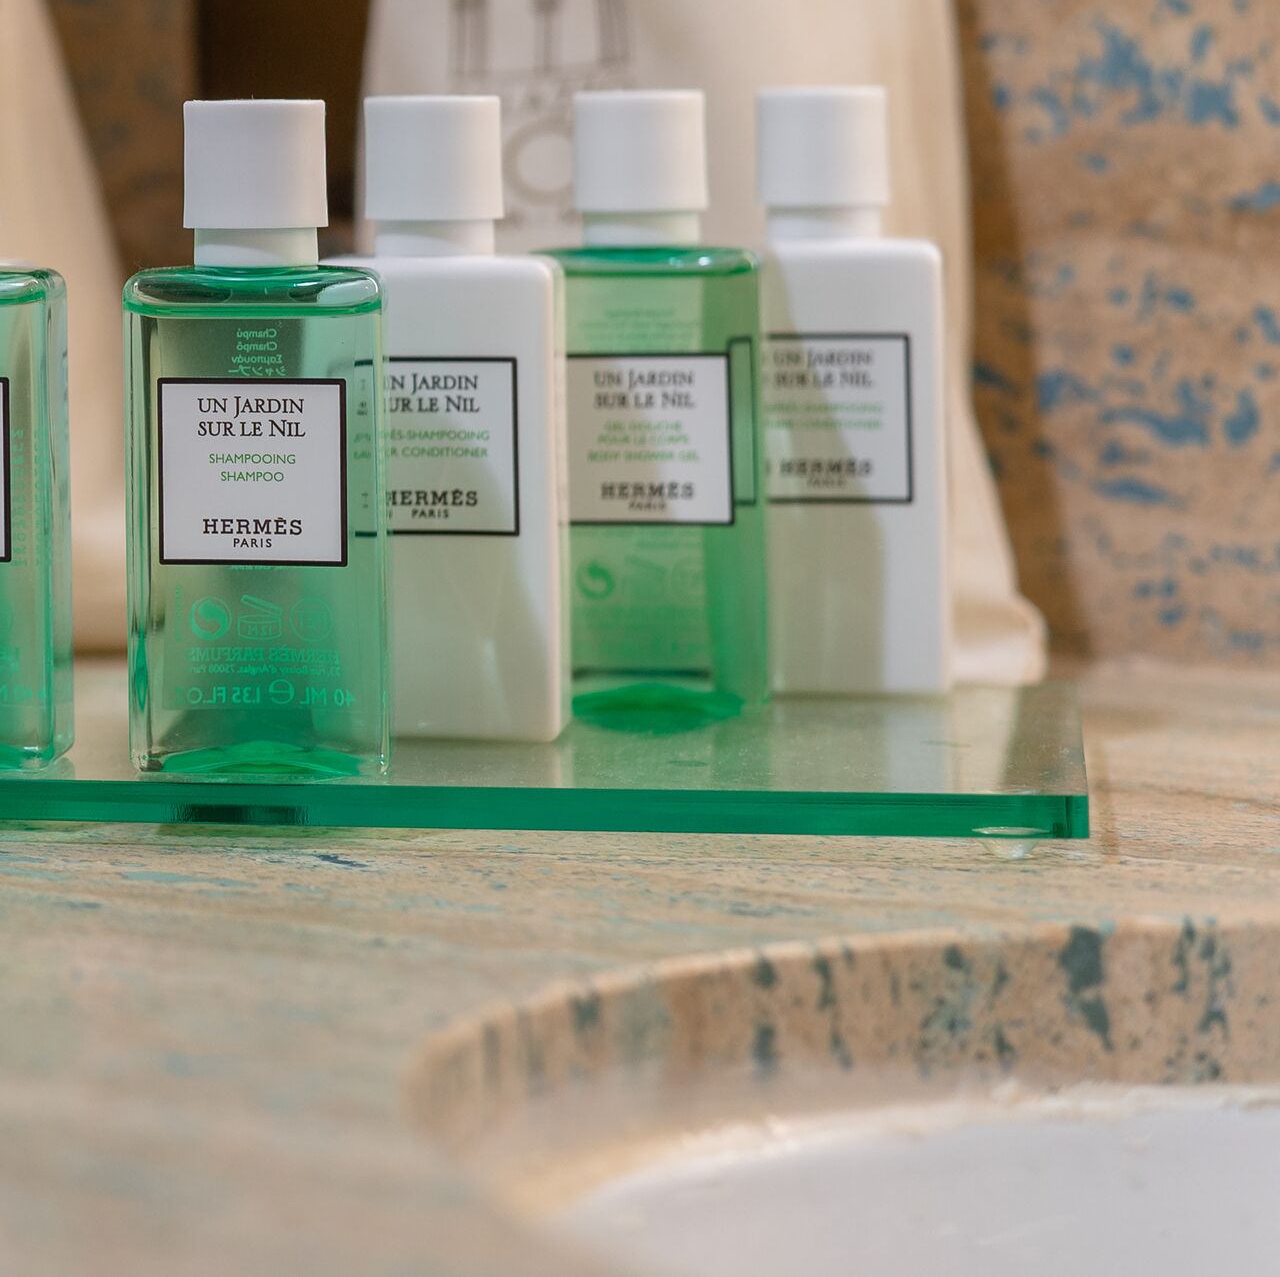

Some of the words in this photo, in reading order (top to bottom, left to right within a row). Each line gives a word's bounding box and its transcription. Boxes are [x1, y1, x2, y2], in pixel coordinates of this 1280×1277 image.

[411, 373, 479, 395] JARDIN
[197, 398, 228, 413] UN
[233, 396, 305, 419] JARDIN
[418, 397, 439, 413] LE
[445, 395, 480, 413] NIL
[197, 421, 236, 437] SUR
[239, 421, 263, 437] LE
[268, 419, 306, 437] NIL
[209, 453, 297, 465] SHAMPOOING
[401, 446, 488, 459] CONDITIONER
[220, 471, 285, 482] SHAMPOO
[411, 508, 450, 519] PARIS
[202, 517, 303, 536] HERMÈS
[233, 538, 273, 548] PARIS
